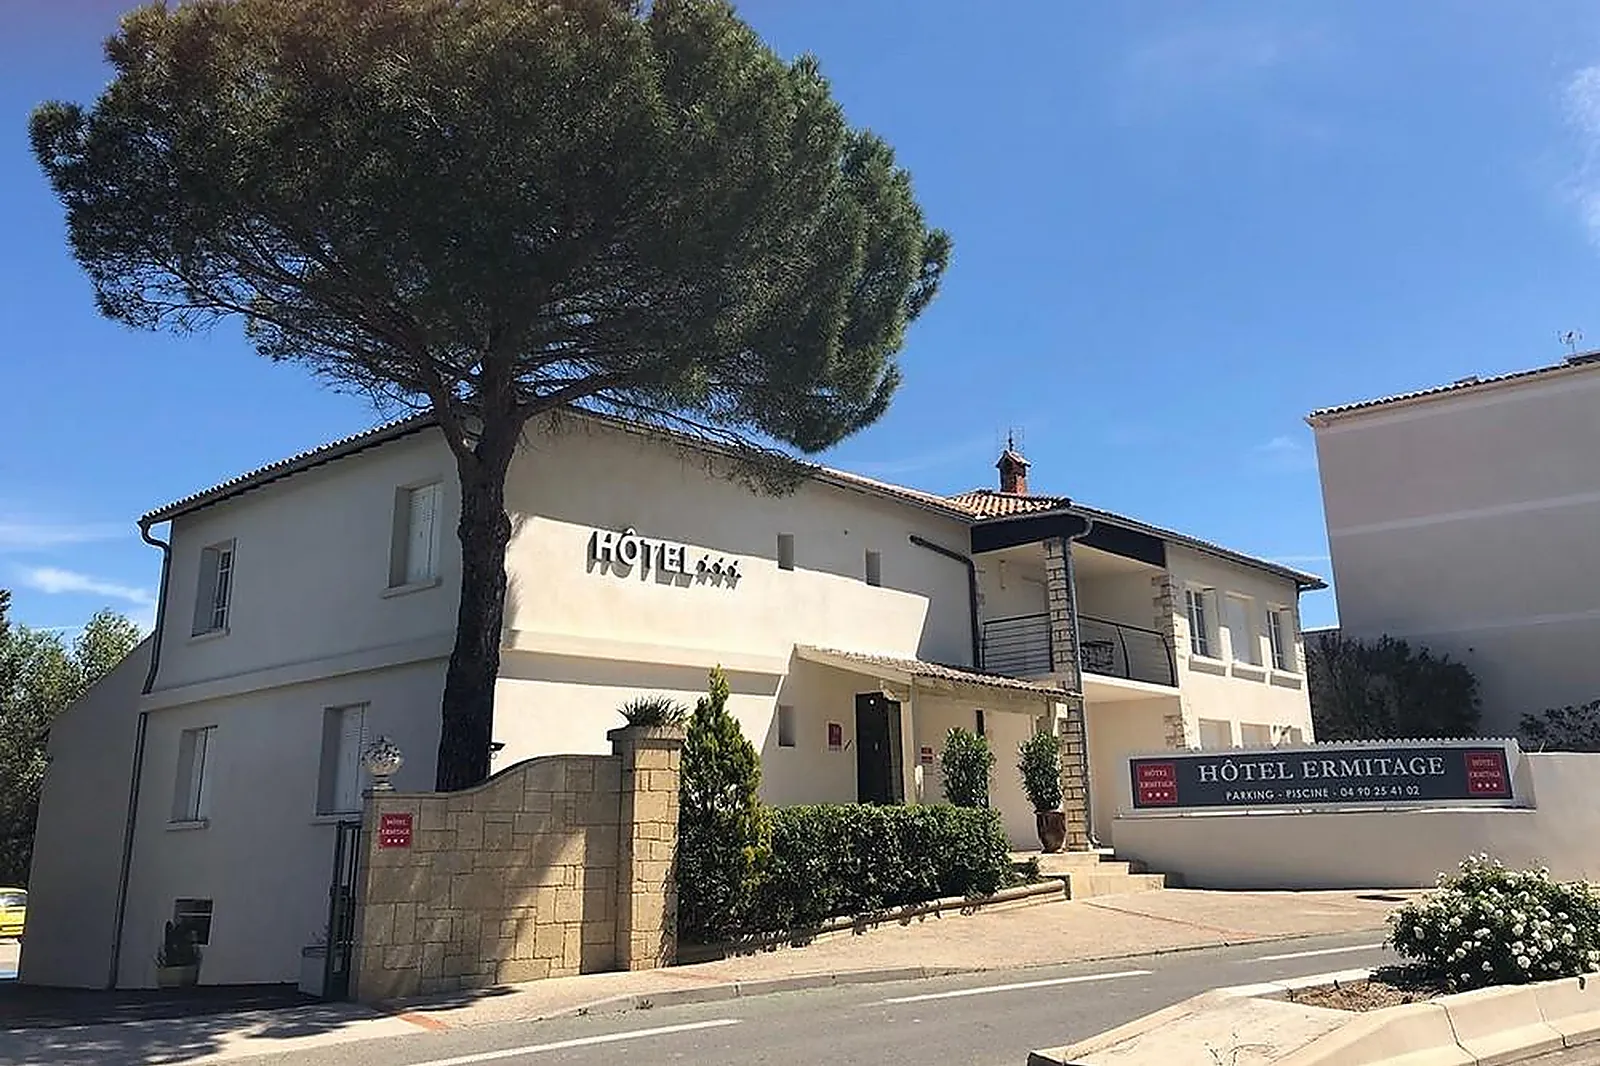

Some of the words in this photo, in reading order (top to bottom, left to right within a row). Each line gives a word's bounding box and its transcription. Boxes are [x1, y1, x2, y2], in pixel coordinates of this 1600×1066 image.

[592, 527, 693, 576] HÔTEL
[1198, 759, 1294, 782] HÔTEL
[1302, 757, 1445, 778] ERMITAGE
[1226, 789, 1274, 801] PARKING
[1286, 788, 1329, 799] PISCINE
[1340, 787, 1354, 797] 04
[1357, 786, 1371, 796] 90
[1374, 786, 1388, 796] 25
[1390, 785, 1402, 796] 41
[1405, 784, 1420, 796] 02
